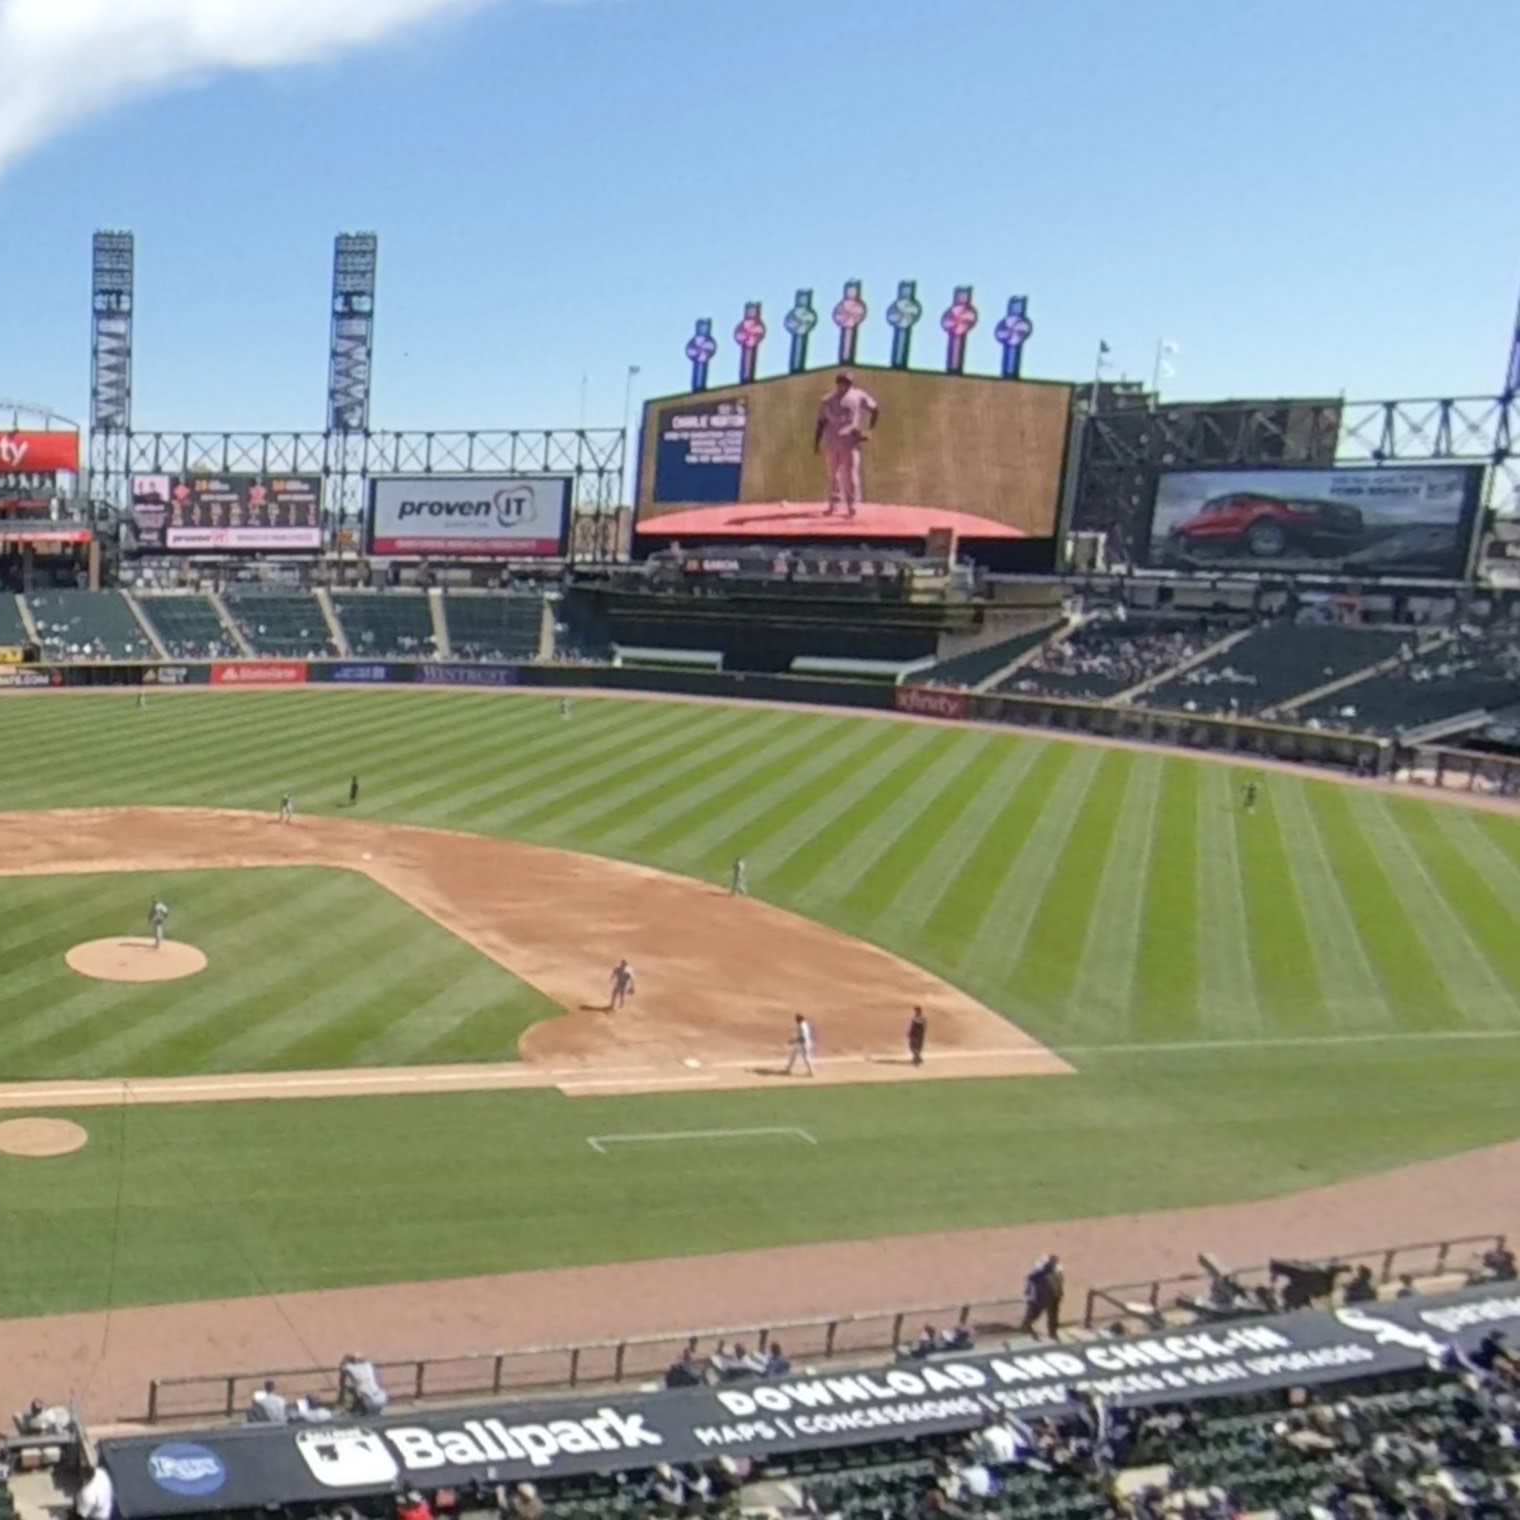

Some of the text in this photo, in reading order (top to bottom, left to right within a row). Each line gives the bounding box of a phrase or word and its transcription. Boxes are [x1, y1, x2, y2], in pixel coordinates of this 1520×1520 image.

[397, 498, 527, 520] proven IT
[898, 693, 960, 715] xfinity
[694, 1420, 776, 1446] MAPS
[795, 1396, 983, 1434] CONCESSIONS
[1181, 1360, 1248, 1384] SEAT
[1246, 1343, 1374, 1375] UPGRADES
[717, 1325, 1289, 1416] DOWNLOAD AND CHECK-IN
[386, 1407, 664, 1470] Ballpark
